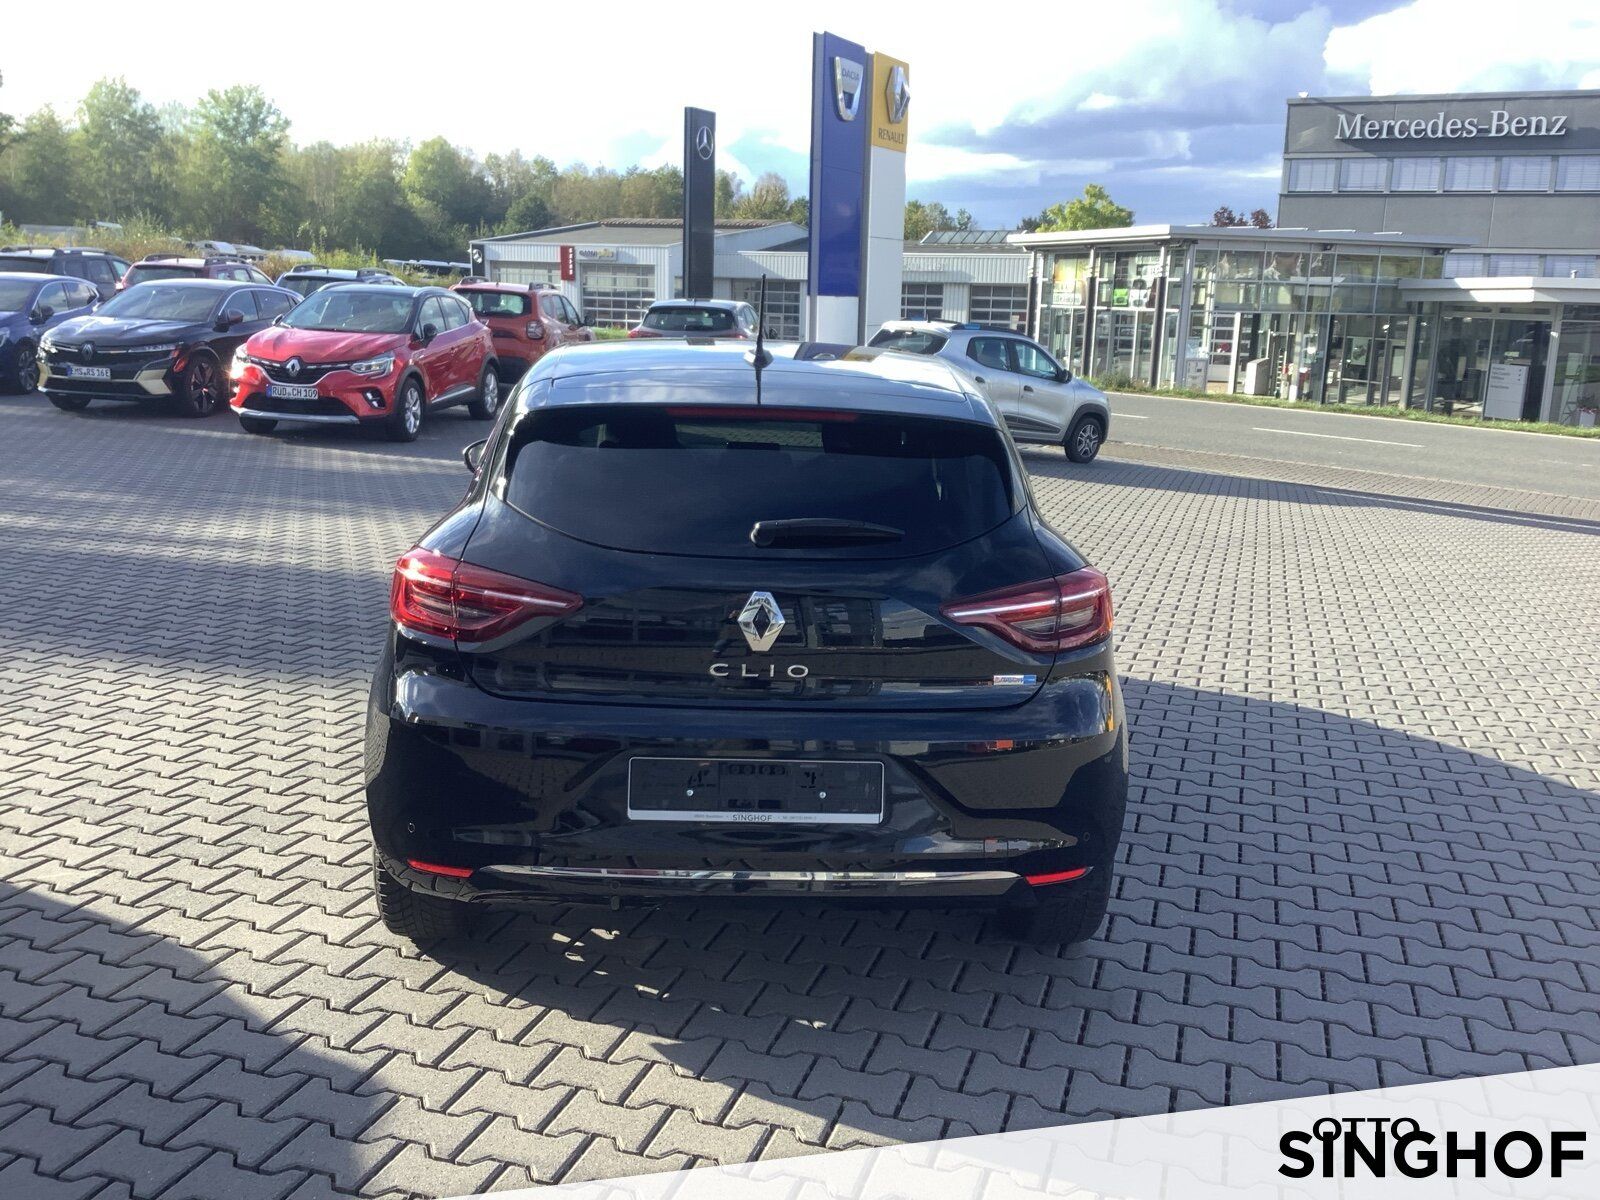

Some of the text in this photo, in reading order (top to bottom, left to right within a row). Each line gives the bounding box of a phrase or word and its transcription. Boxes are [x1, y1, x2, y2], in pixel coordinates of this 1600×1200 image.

[842, 68, 860, 80] DACIA
[1334, 110, 1568, 140] Mercedes-Benz
[878, 127, 905, 144] RENAULT
[272, 386, 318, 398] RUD CH 109
[709, 663, 809, 678] CLIO
[732, 813, 773, 822] SINGHOF
